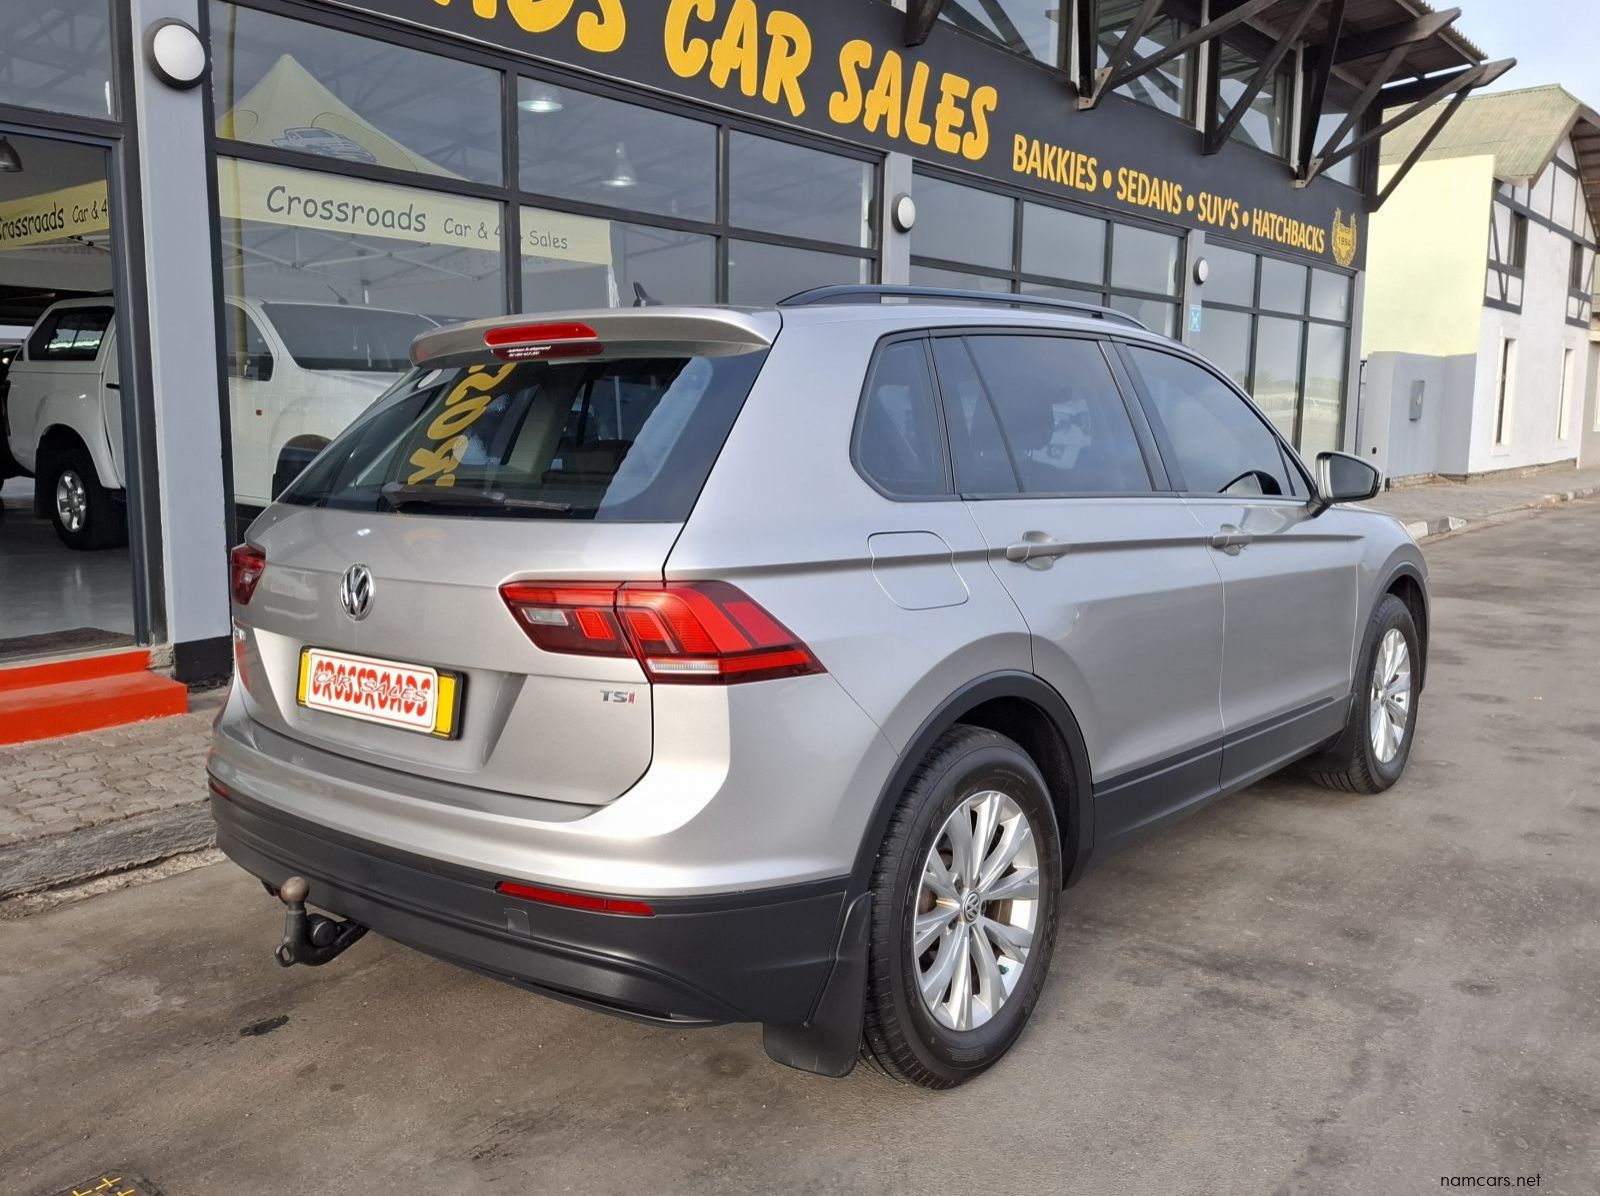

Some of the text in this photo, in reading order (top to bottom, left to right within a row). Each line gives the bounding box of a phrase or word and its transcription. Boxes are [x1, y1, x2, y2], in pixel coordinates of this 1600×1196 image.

[664, 0, 812, 117] CAR
[829, 39, 997, 160] SALES
[72, 205, 88, 224] Car
[91, 200, 100, 220] &
[266, 185, 426, 232] Crossroads
[443, 217, 472, 238] Car
[477, 222, 488, 239] &
[529, 230, 568, 250] Sales
[1012, 133, 1325, 254] BAKKIES SEDANS SUV'S HATCHBACKS
[312, 660, 431, 717] CROSSROADS
[315, 671, 428, 702] CAR SALES
